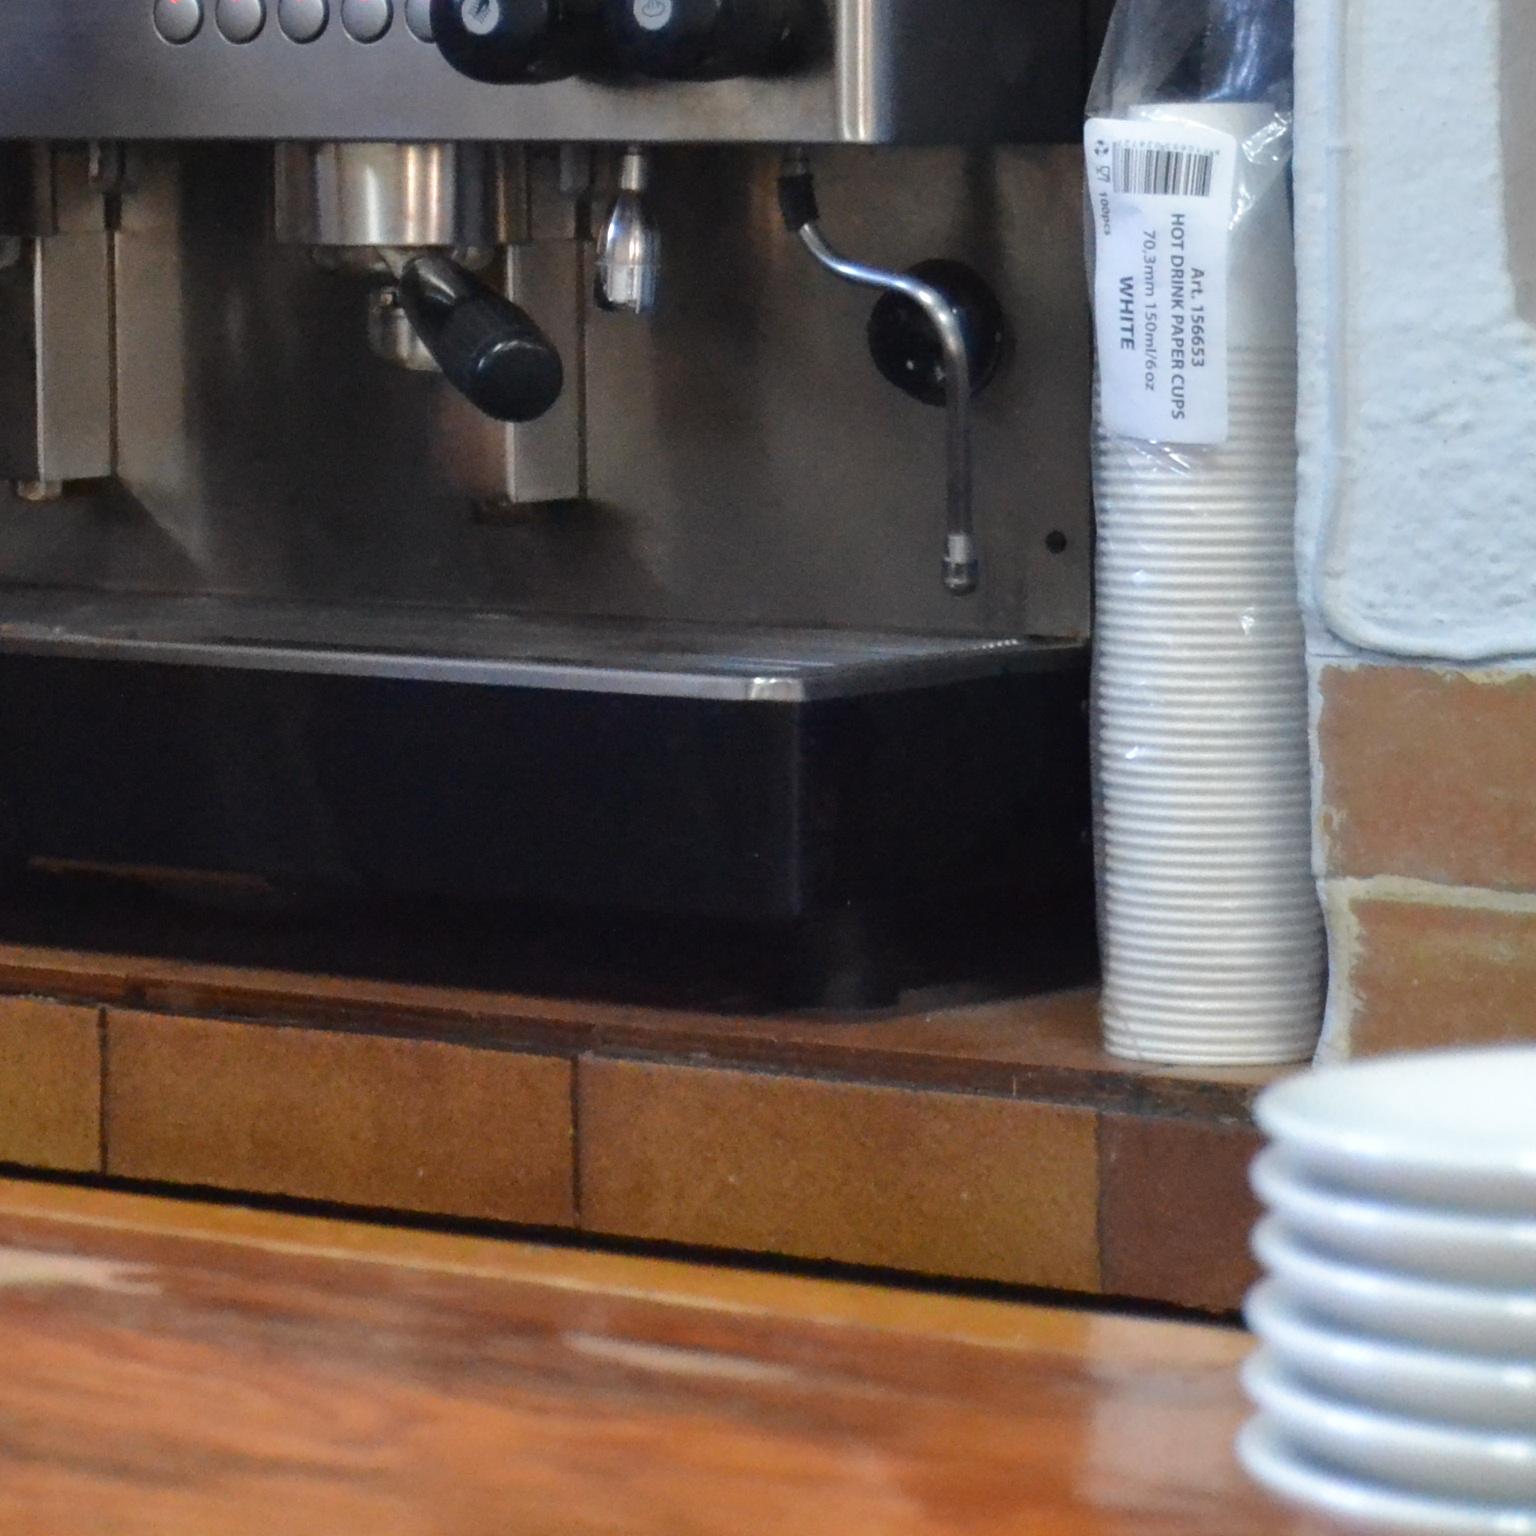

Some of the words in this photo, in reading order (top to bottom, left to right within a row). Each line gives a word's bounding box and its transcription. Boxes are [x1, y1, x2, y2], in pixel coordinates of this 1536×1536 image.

[1099, 192, 1111, 235] 100pcs
[1171, 214, 1185, 250] HOT
[1142, 230, 1156, 296] 70,3mm
[1171, 255, 1185, 310] DRINK
[1191, 268, 1205, 299] Art.
[1120, 276, 1135, 350] WHITE
[1191, 305, 1205, 366] 156653
[1171, 315, 1185, 369] PAPER
[1171, 374, 1185, 419] CUPS
